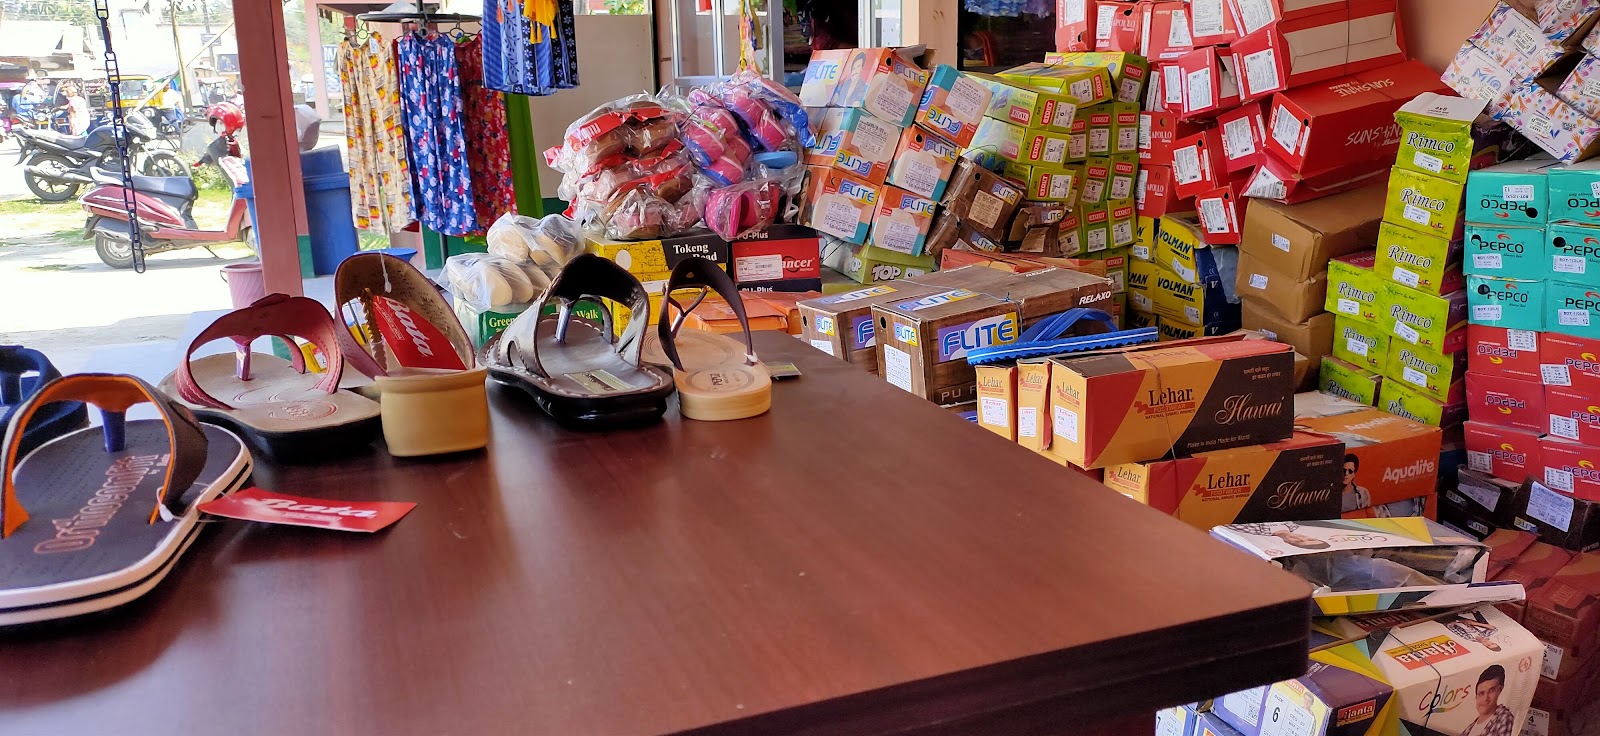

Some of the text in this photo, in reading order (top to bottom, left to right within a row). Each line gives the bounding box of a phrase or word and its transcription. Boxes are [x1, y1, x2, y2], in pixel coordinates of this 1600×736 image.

[894, 63, 926, 85] FLITE
[1125, 65, 1142, 77] STOUT
[1095, 76, 1103, 98] STOUT
[1336, 78, 1394, 98] SUNSHINE
[927, 109, 962, 133] FLITE
[1010, 107, 1029, 122] STOUT
[1043, 101, 1053, 124] STOUT
[1091, 115, 1110, 124] STOUT
[1118, 114, 1136, 123] STOUT
[816, 131, 842, 151] FLIT
[1345, 124, 1402, 147] SUNSHIN
[1407, 131, 1455, 153] Rimco
[925, 141, 957, 161] FLITE
[1032, 137, 1042, 159] STOUT
[1139, 150, 1151, 159] ata
[837, 152, 870, 174] FLITE
[1089, 167, 1107, 177] STOUT
[1116, 164, 1133, 173] STOUT
[841, 180, 875, 203] FLITE
[1039, 174, 1049, 198] STOUT
[902, 198, 934, 216] FLITE
[1400, 188, 1445, 211] Rimco
[1480, 199, 1528, 212] PEPCO
[1088, 211, 1106, 221] STOUT
[1114, 208, 1131, 218] STOUT
[673, 243, 709, 257] Tokeng
[1158, 229, 1191, 254] VOLMAN
[1479, 241, 1524, 253] PEPCO
[1387, 243, 1431, 269] Rimco
[1563, 245, 1600, 258] PEPC
[782, 257, 813, 270] ancer
[873, 265, 900, 280] TOP
[1157, 277, 1195, 297] VOLMAN
[1338, 282, 1375, 302] Rimco
[1487, 290, 1528, 302] PEPCO
[898, 289, 973, 311] FLITE
[1079, 291, 1111, 305] RELAXO
[1565, 297, 1600, 311] PEPC
[489, 317, 516, 329] Green
[576, 309, 598, 319] Walk
[1390, 304, 1433, 328] Rimco
[384, 297, 434, 357] Bata
[817, 318, 833, 335] FLITE
[896, 325, 916, 343] FLITE
[943, 320, 1014, 357] FLITE
[1343, 326, 1377, 349] Rimco
[1477, 345, 1517, 358] PEPCO
[1399, 349, 1438, 375] Rimco
[1565, 357, 1600, 374] PEPC
[983, 377, 1004, 388] Lehar
[1025, 372, 1044, 384] Lehar
[941, 389, 961, 403] PU
[1061, 381, 1080, 400] Lehar
[1149, 387, 1194, 407] Lehar
[1214, 393, 1285, 426] Hawai
[1486, 395, 1525, 409] PEPCO
[1487, 448, 1526, 464] PEPCO
[1117, 466, 1141, 485] Lehar
[1208, 472, 1250, 490] Lehar
[1382, 459, 1435, 485] Aqualite
[1267, 480, 1334, 510] Hawai
[252, 498, 377, 519] Bata
[1396, 640, 1457, 663] Ajanta
[1418, 684, 1471, 712] Colors
[1272, 706, 1280, 723] 6
